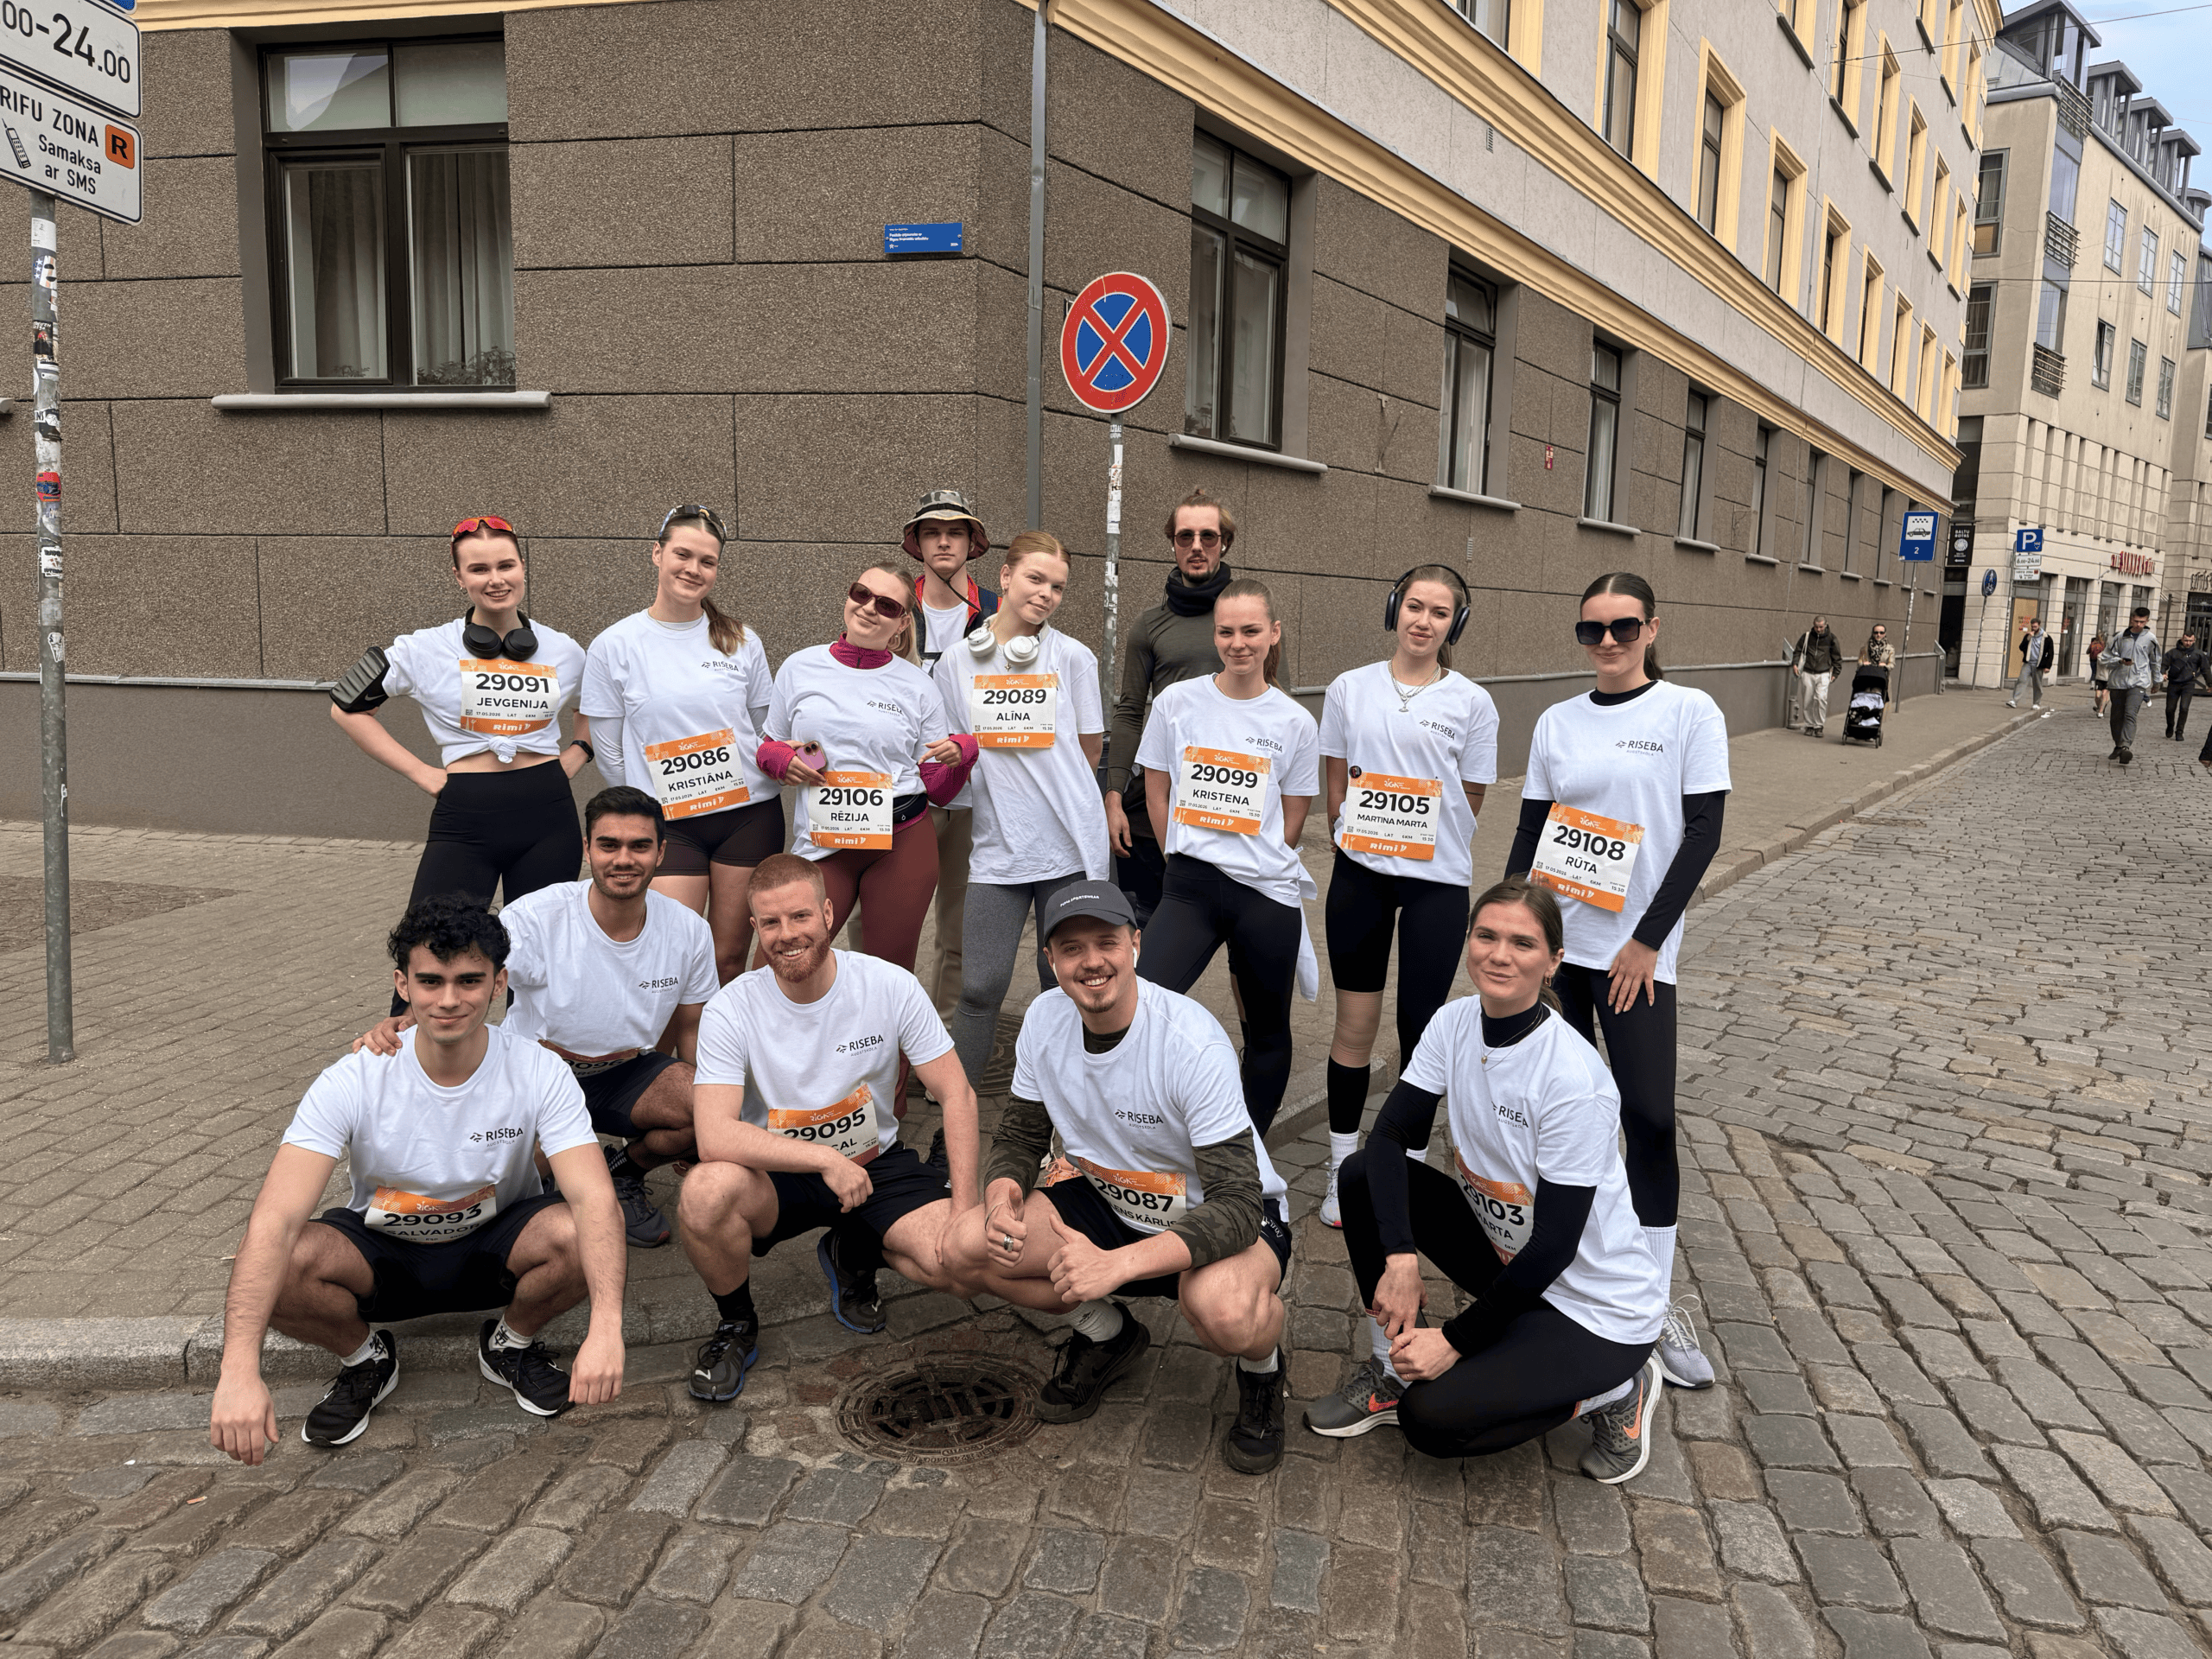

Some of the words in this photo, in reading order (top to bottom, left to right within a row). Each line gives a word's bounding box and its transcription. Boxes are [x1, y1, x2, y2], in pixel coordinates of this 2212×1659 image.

[0, 85, 42, 122] RIFU
[53, 108, 99, 148] ZONA
[39, 134, 101, 175] Samaksa
[111, 134, 128, 160] R
[45, 164, 60, 180] ar
[67, 168, 96, 195] SMS
[2023, 532, 2037, 550] P
[1914, 546, 1919, 555] 2
[476, 673, 550, 694] 29091
[477, 697, 549, 709] JEVGENIJA
[982, 689, 1046, 704] 29089
[996, 710, 1031, 721] ALĪNA
[1431, 721, 1455, 741] RISEBA
[1256, 738, 1283, 753] RISEBA
[1628, 741, 1663, 753] RISEBA
[660, 747, 730, 776] 29086
[668, 770, 734, 792] KRISTIĀNA
[1191, 764, 1258, 789] 29099
[818, 788, 884, 806] 29106
[1192, 789, 1250, 806] KRISTENA
[1358, 790, 1430, 815] 29105
[830, 810, 869, 822] RĒZIJA
[1357, 814, 1395, 825] MARTINA
[1395, 819, 1427, 829] MARTA
[1553, 824, 1626, 861] 29108
[1565, 855, 1598, 874] RŪTA
[652, 976, 679, 988] RISEBA
[849, 1034, 884, 1052] RISEBA
[1128, 1111, 1164, 1124] RISEBA
[486, 1128, 524, 1141] RISEBA
[1094, 1177, 1173, 1212] 29087
[1460, 1173, 1525, 1226] 29103
[383, 1202, 482, 1227] 29093
[386, 1224, 480, 1236] SALVADOR
